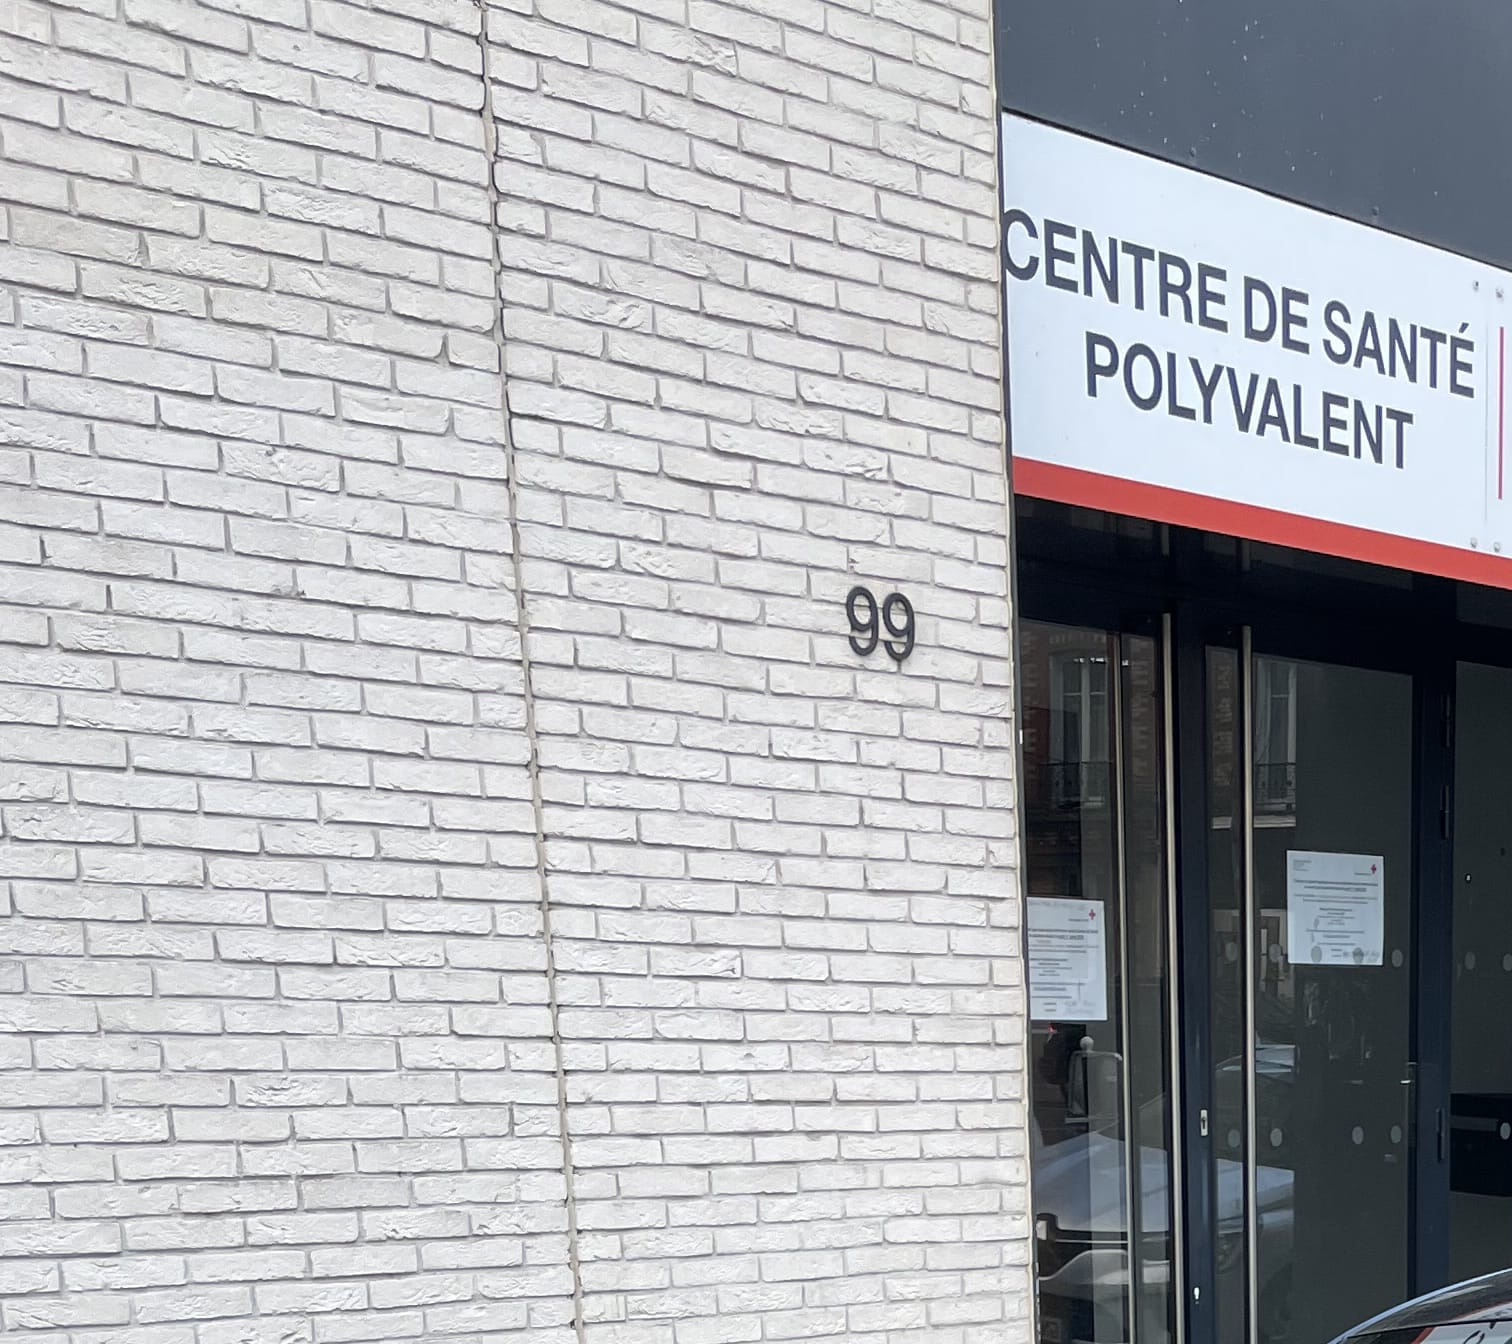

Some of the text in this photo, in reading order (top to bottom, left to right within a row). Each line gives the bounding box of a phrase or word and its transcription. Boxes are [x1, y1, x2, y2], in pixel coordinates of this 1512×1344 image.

[1002, 208, 1476, 399] CENTRE DE SANTÉ
[1085, 331, 1414, 469] POLYVALENT
[846, 586, 915, 660] 99
